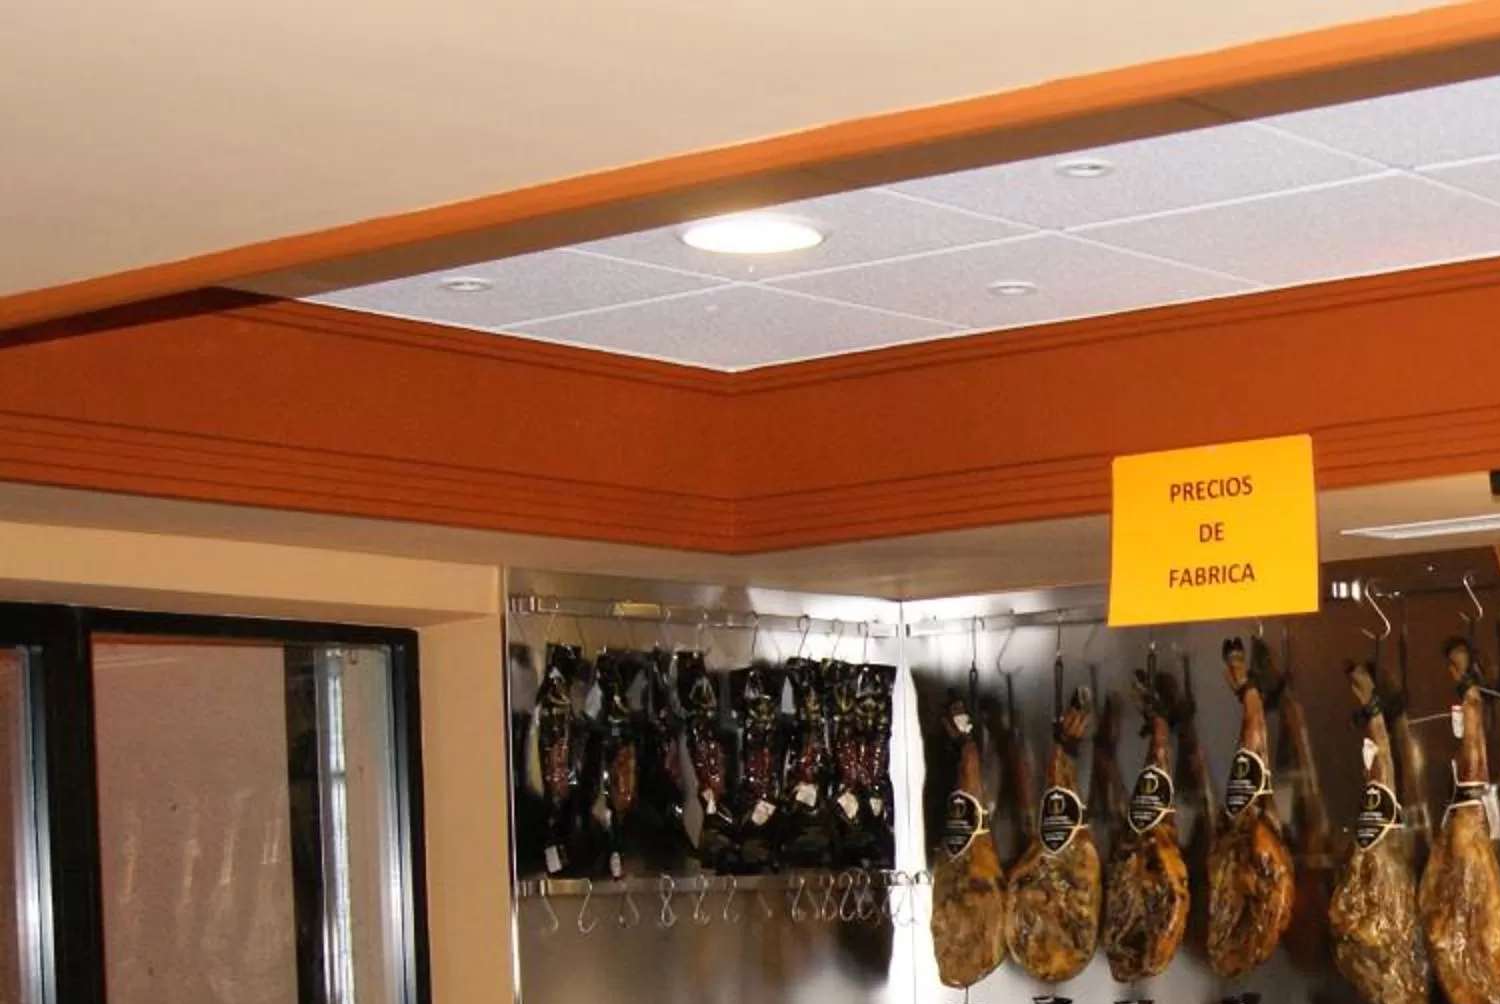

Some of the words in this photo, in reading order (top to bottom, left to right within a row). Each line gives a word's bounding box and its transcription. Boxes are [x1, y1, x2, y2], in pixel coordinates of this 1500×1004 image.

[1170, 475, 1253, 504] PRECIOS
[1199, 522, 1225, 543] DE
[1168, 563, 1255, 589] FABRICA
